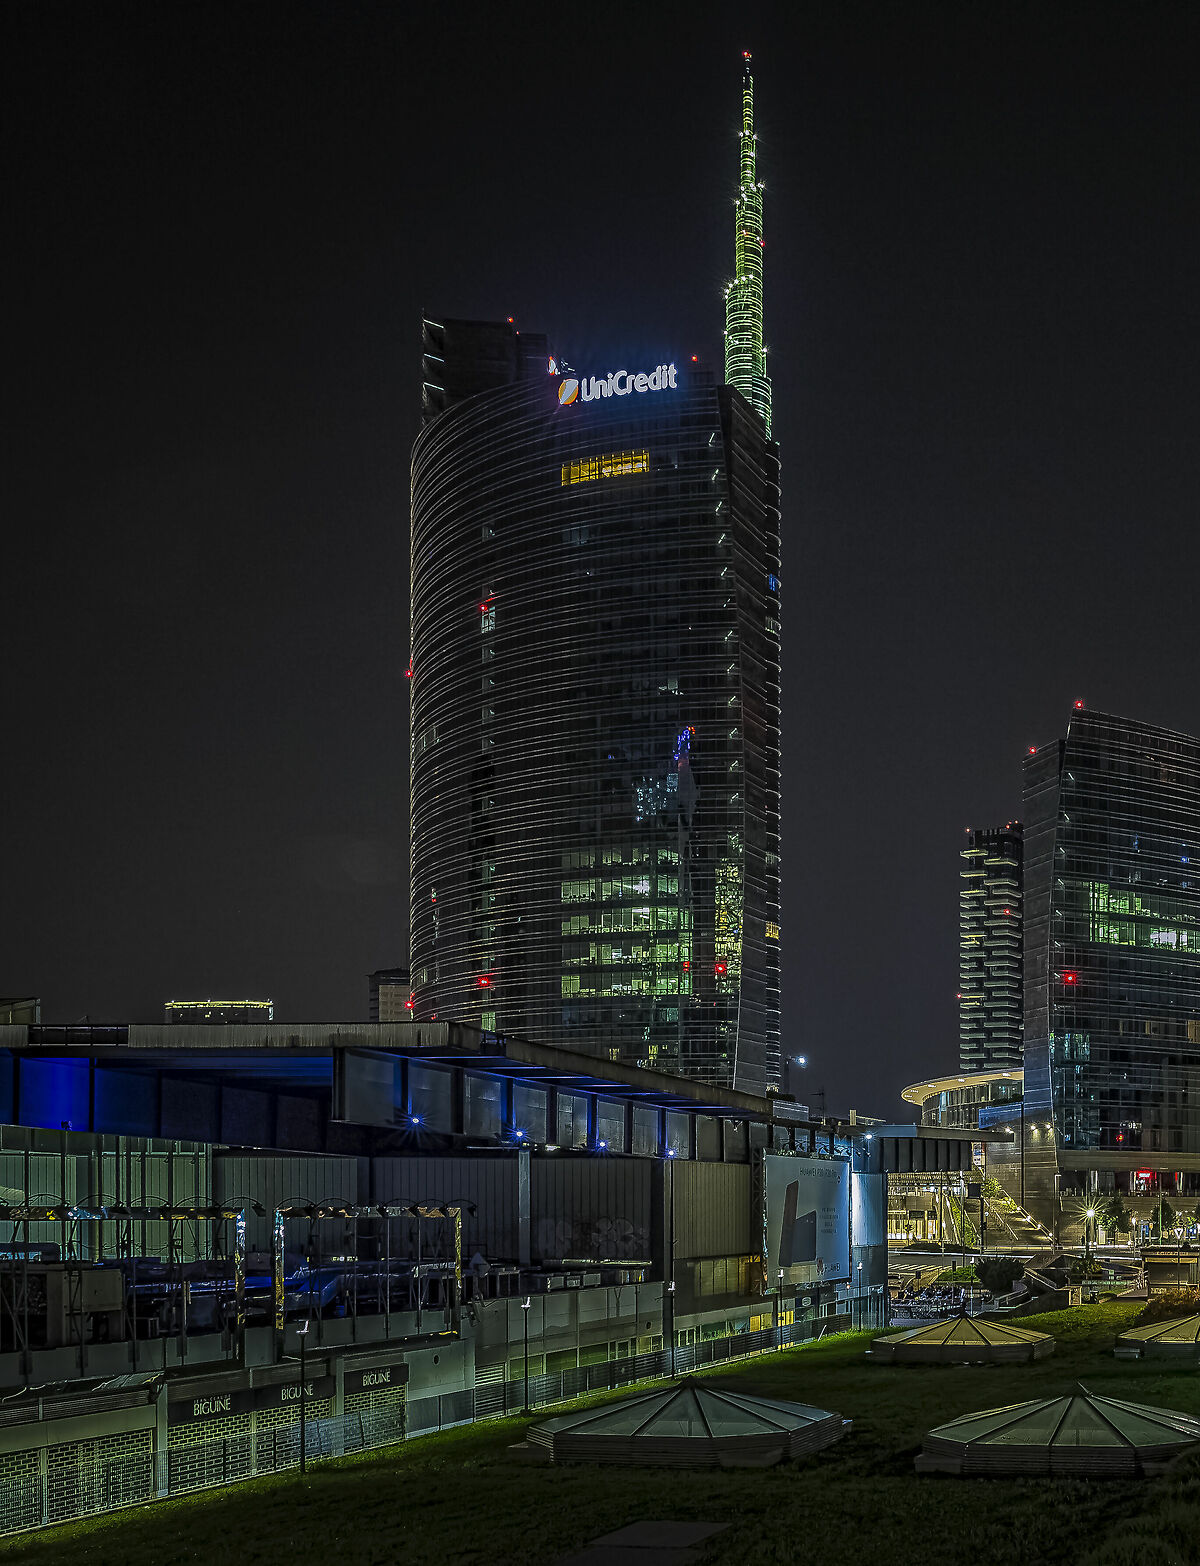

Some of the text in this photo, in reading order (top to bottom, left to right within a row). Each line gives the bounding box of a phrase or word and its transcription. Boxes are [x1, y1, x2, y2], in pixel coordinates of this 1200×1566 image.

[581, 364, 677, 402] UniCredit
[362, 1371, 391, 1387] BIGUINE
[282, 1382, 313, 1401] BIGUNE
[194, 1398, 231, 1417] BIGUINE
